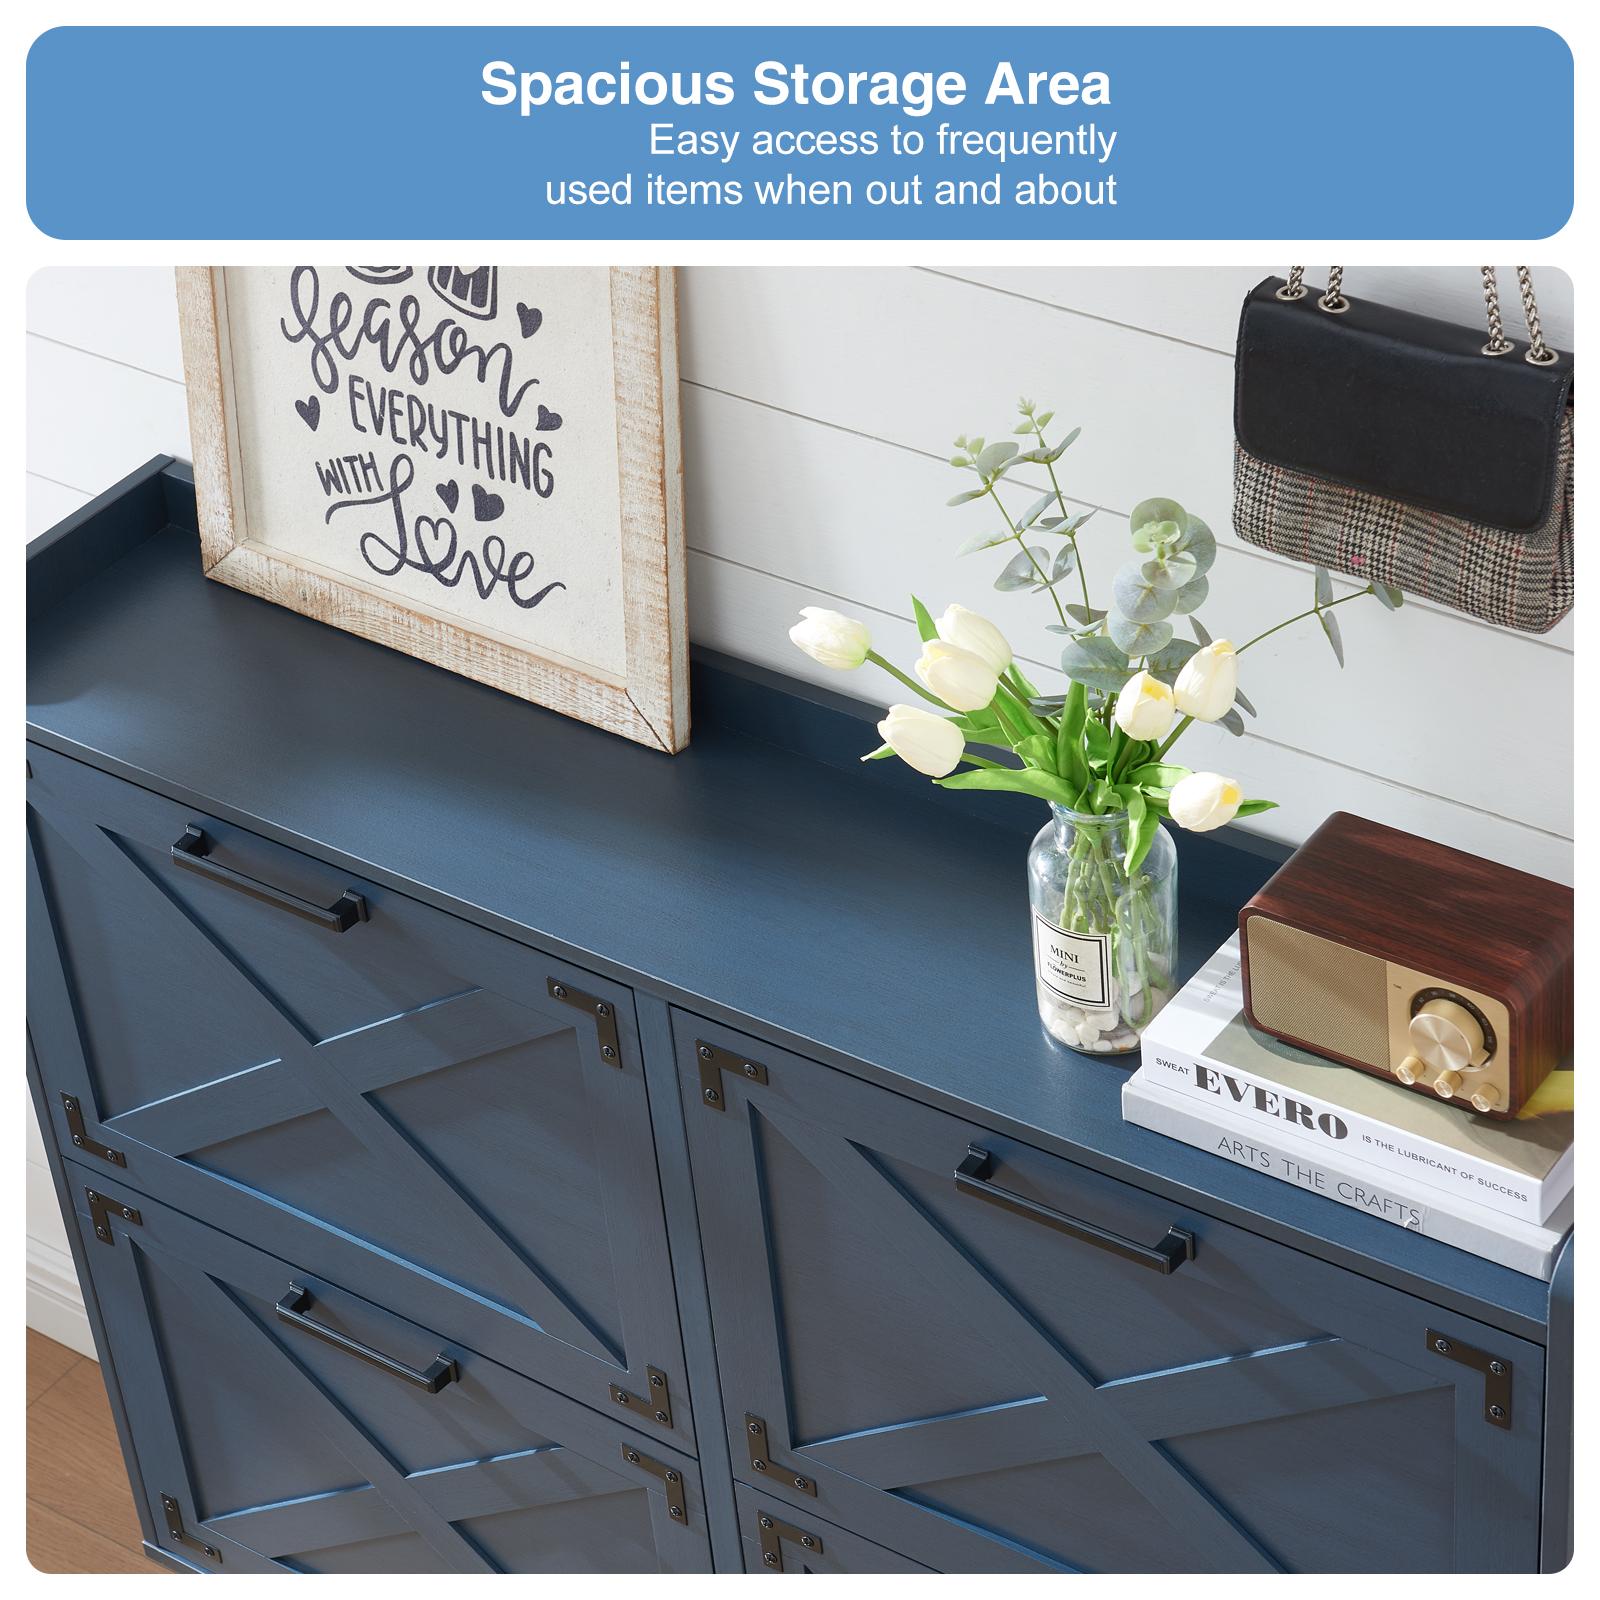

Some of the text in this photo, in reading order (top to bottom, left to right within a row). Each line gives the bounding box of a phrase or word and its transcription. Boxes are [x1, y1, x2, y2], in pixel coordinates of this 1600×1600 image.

[315, 451, 384, 496] WITH
[349, 374, 555, 499] EVERYTHING
[325, 453, 567, 609] Love
[1050, 944, 1079, 963] MINI
[1155, 1057, 1528, 1202] SWEAT EVERO IS THE LUBRICANT OF SUCCESS
[1217, 1136, 1420, 1226] ARTS THE CRAFTS
